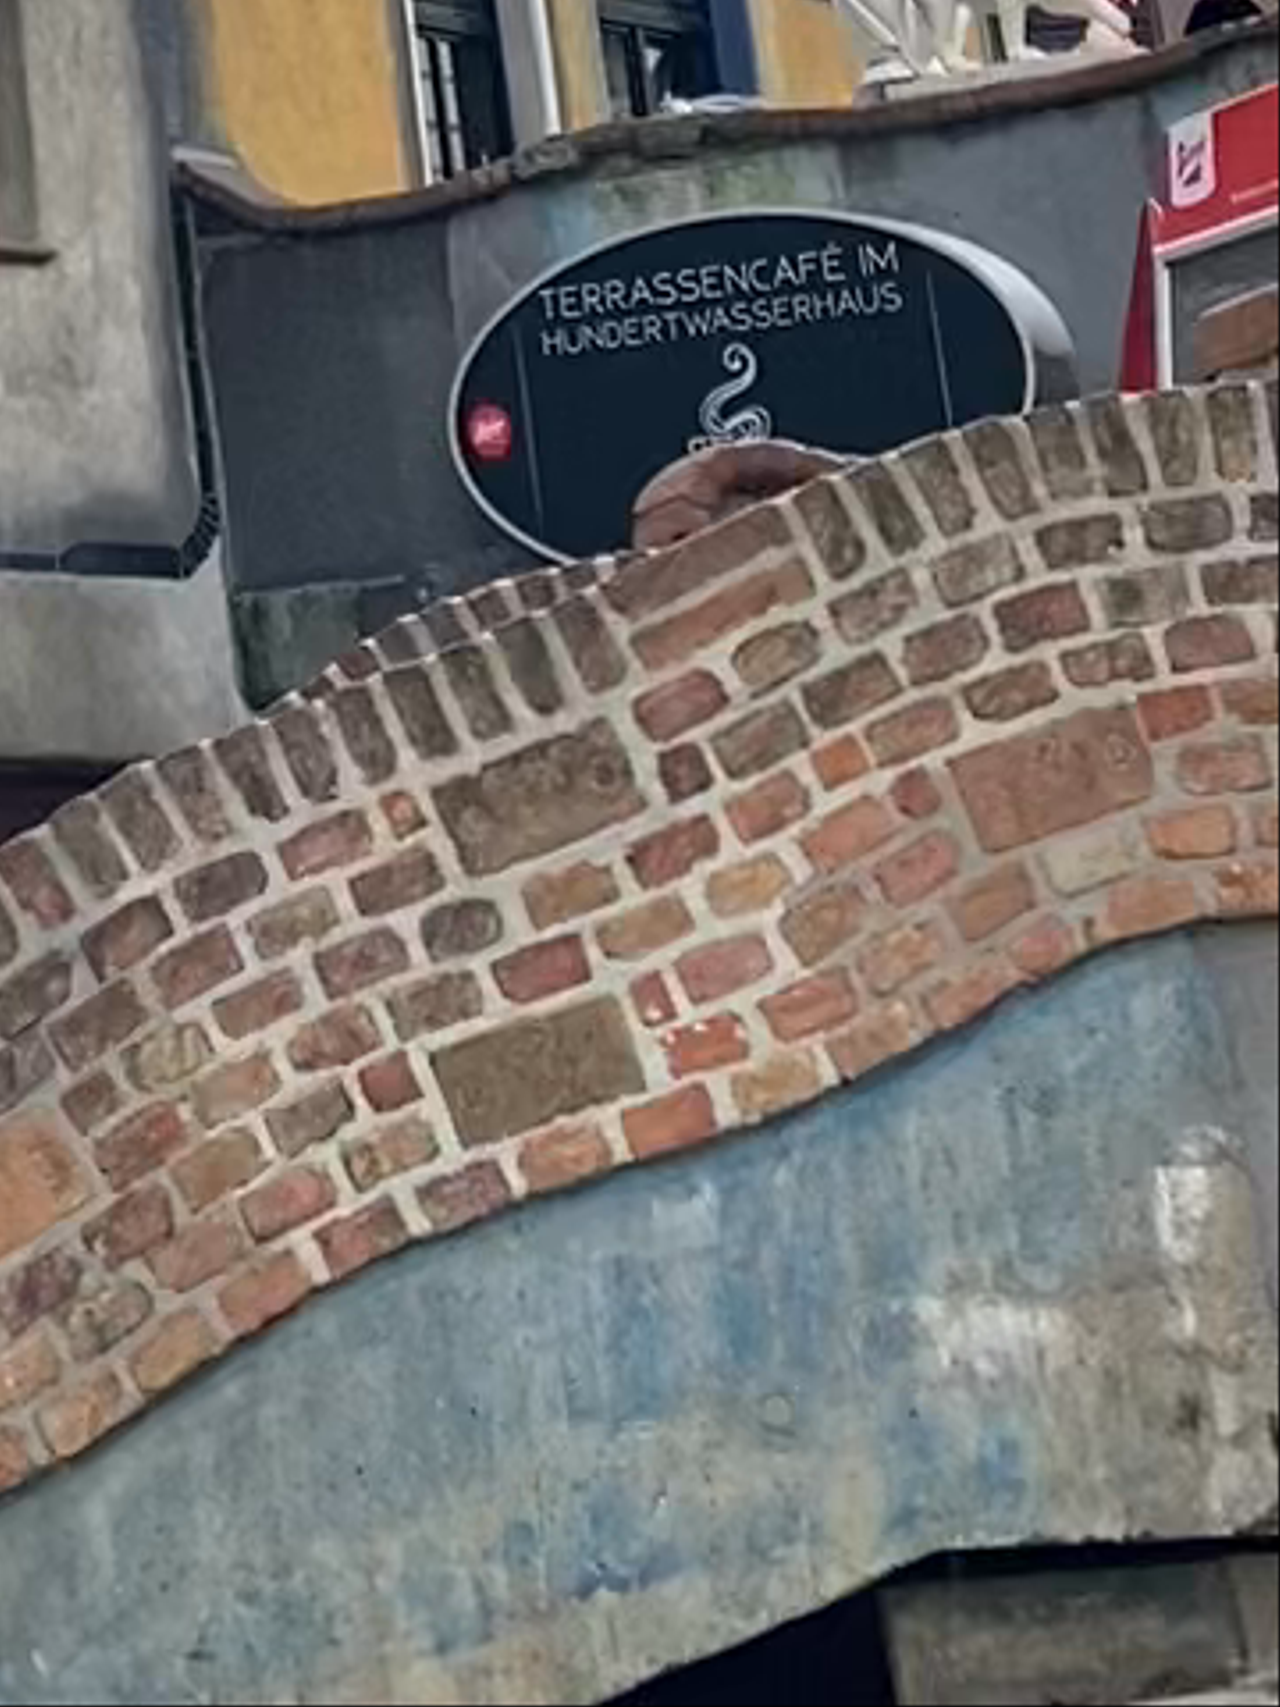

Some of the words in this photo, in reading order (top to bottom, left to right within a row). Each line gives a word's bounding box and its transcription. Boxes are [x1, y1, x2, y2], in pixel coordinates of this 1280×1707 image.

[538, 241, 846, 320] TERRASSENCAFÉ
[858, 240, 899, 277] IM
[540, 281, 903, 356] HUNDERTWASSERHAUS
